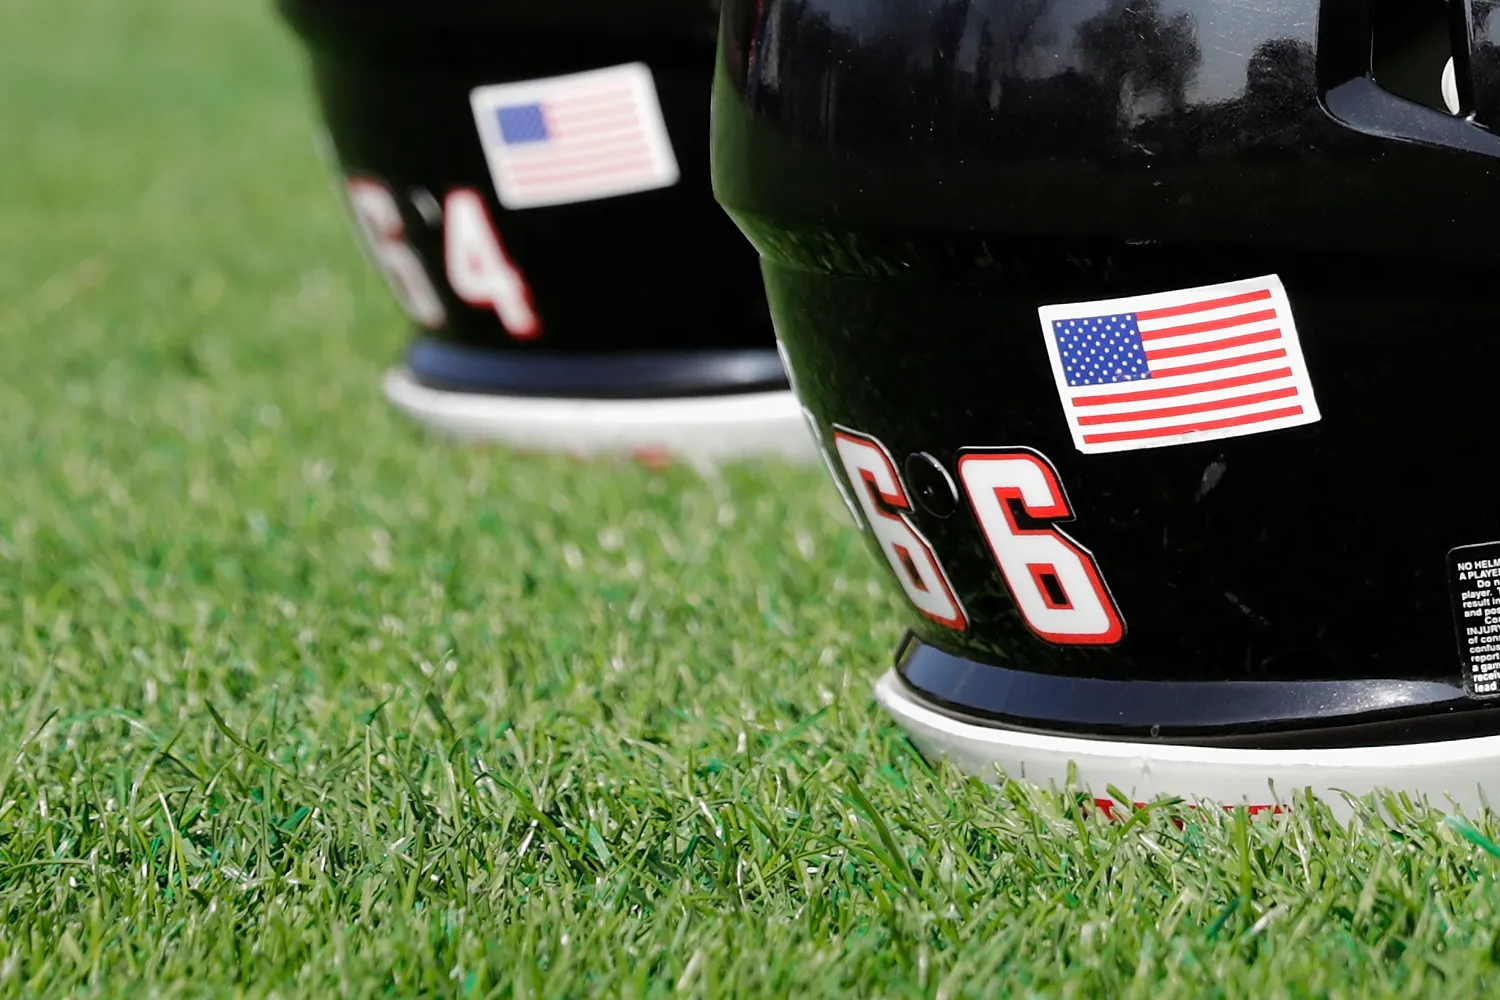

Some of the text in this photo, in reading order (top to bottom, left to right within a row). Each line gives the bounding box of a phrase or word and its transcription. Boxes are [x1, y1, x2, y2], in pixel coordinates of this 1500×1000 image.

[1457, 563, 1472, 571] NO
[1459, 572, 1466, 580] A
[1477, 579, 1491, 588] Do
[1461, 590, 1492, 600] player.
[1463, 598, 1490, 608] result
[1464, 608, 1482, 617] and
[1468, 636, 1478, 644] of
[1471, 652, 1500, 663] report
[1474, 681, 1497, 692] lead
